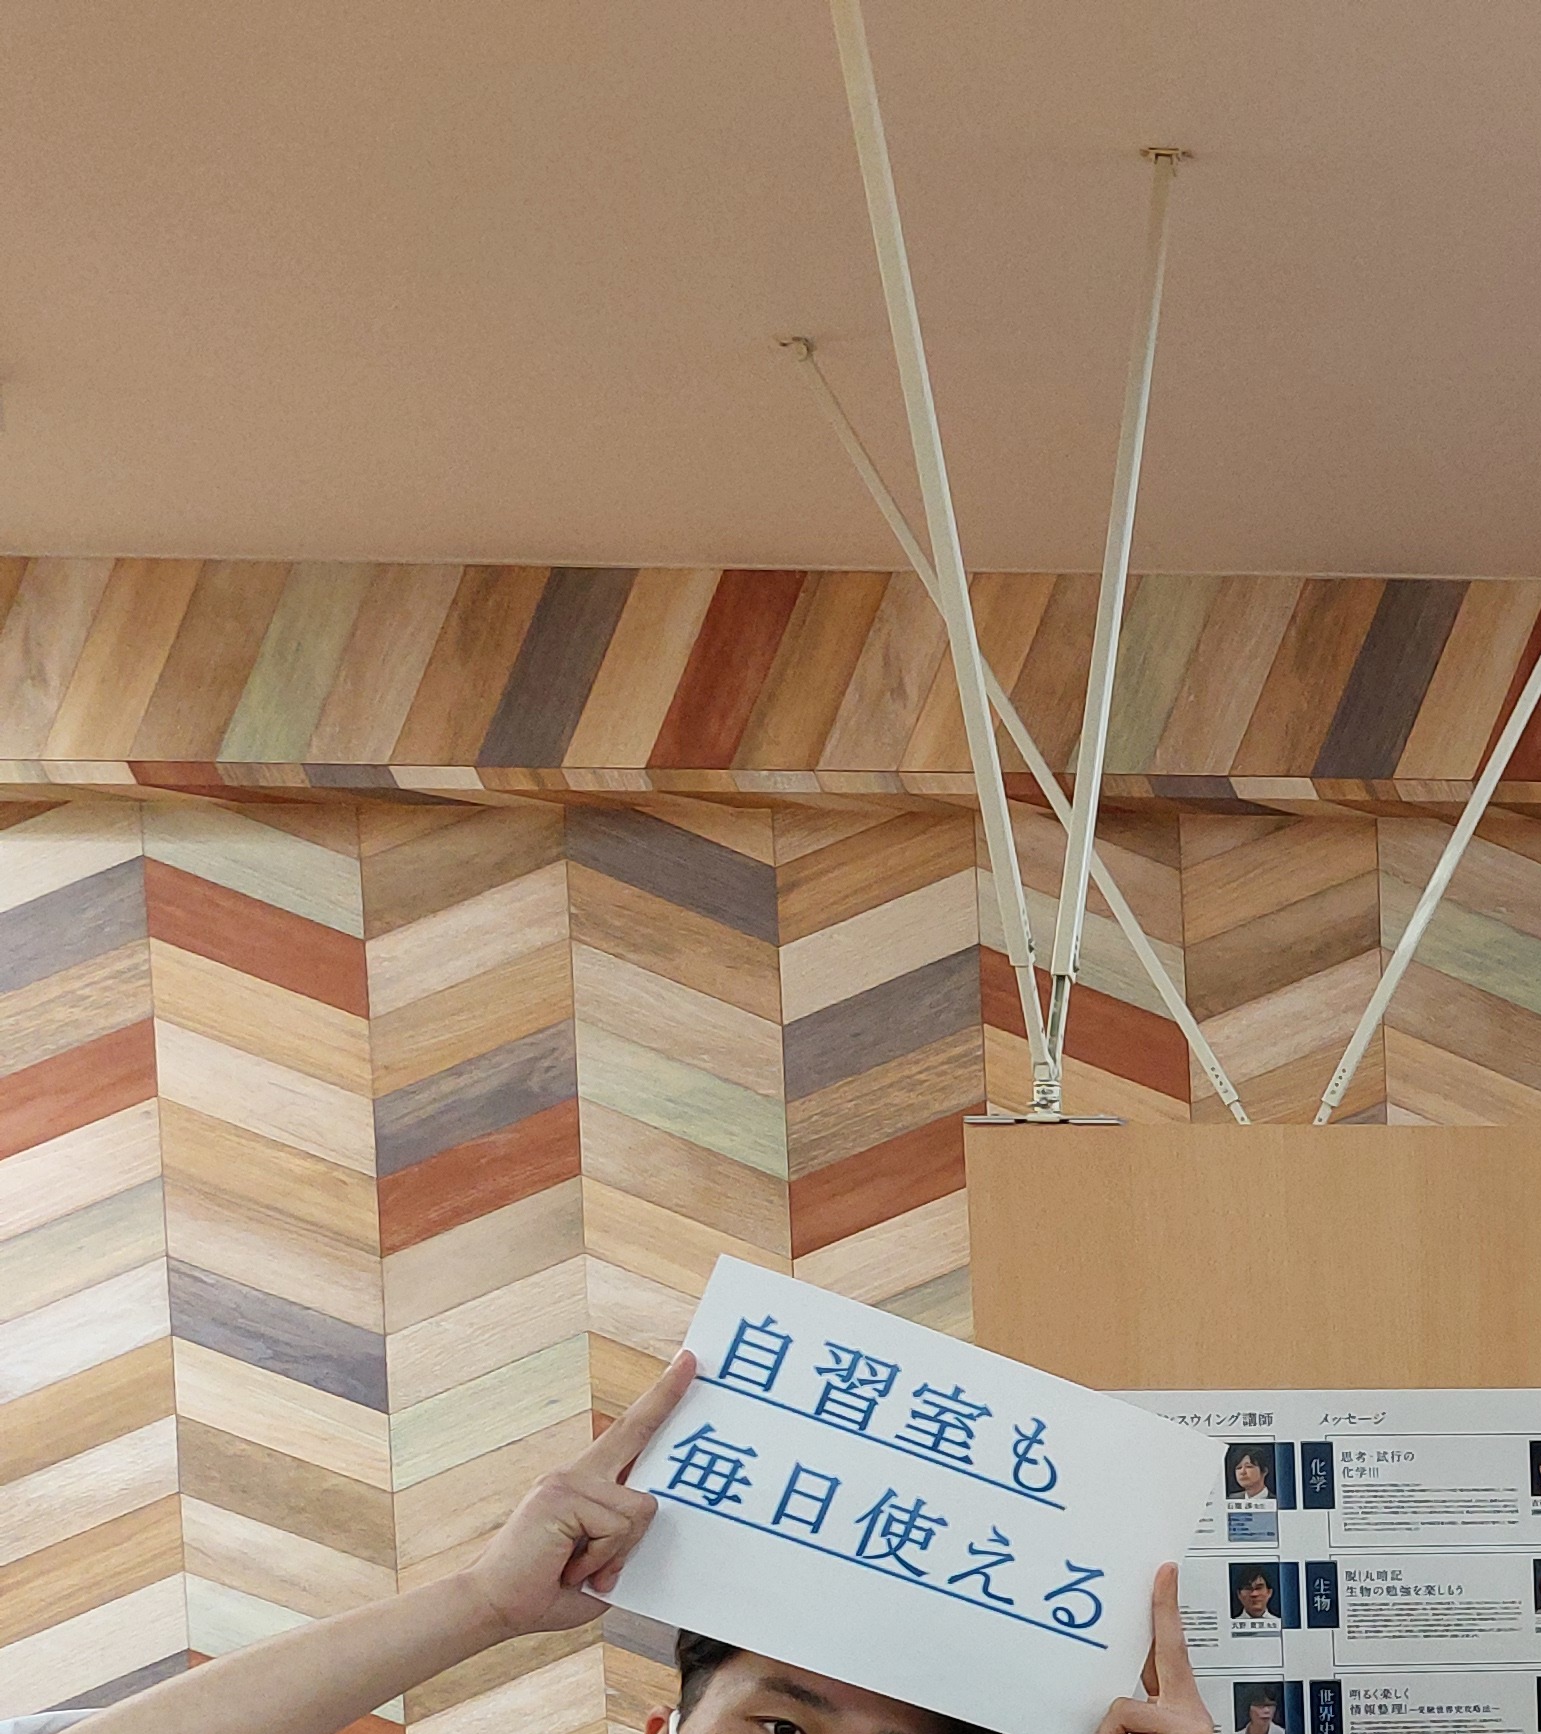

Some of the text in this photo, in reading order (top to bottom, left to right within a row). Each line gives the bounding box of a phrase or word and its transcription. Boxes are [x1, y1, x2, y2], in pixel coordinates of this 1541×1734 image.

[716, 1314, 1060, 1493] 自習室も
[1168, 1411, 1274, 1427] スウイング講師
[1319, 1411, 1387, 1426] メッセージ
[1309, 1457, 1329, 1493] 化学
[664, 1422, 1106, 1631] 毎日使える
[1313, 1578, 1331, 1612] 生物
